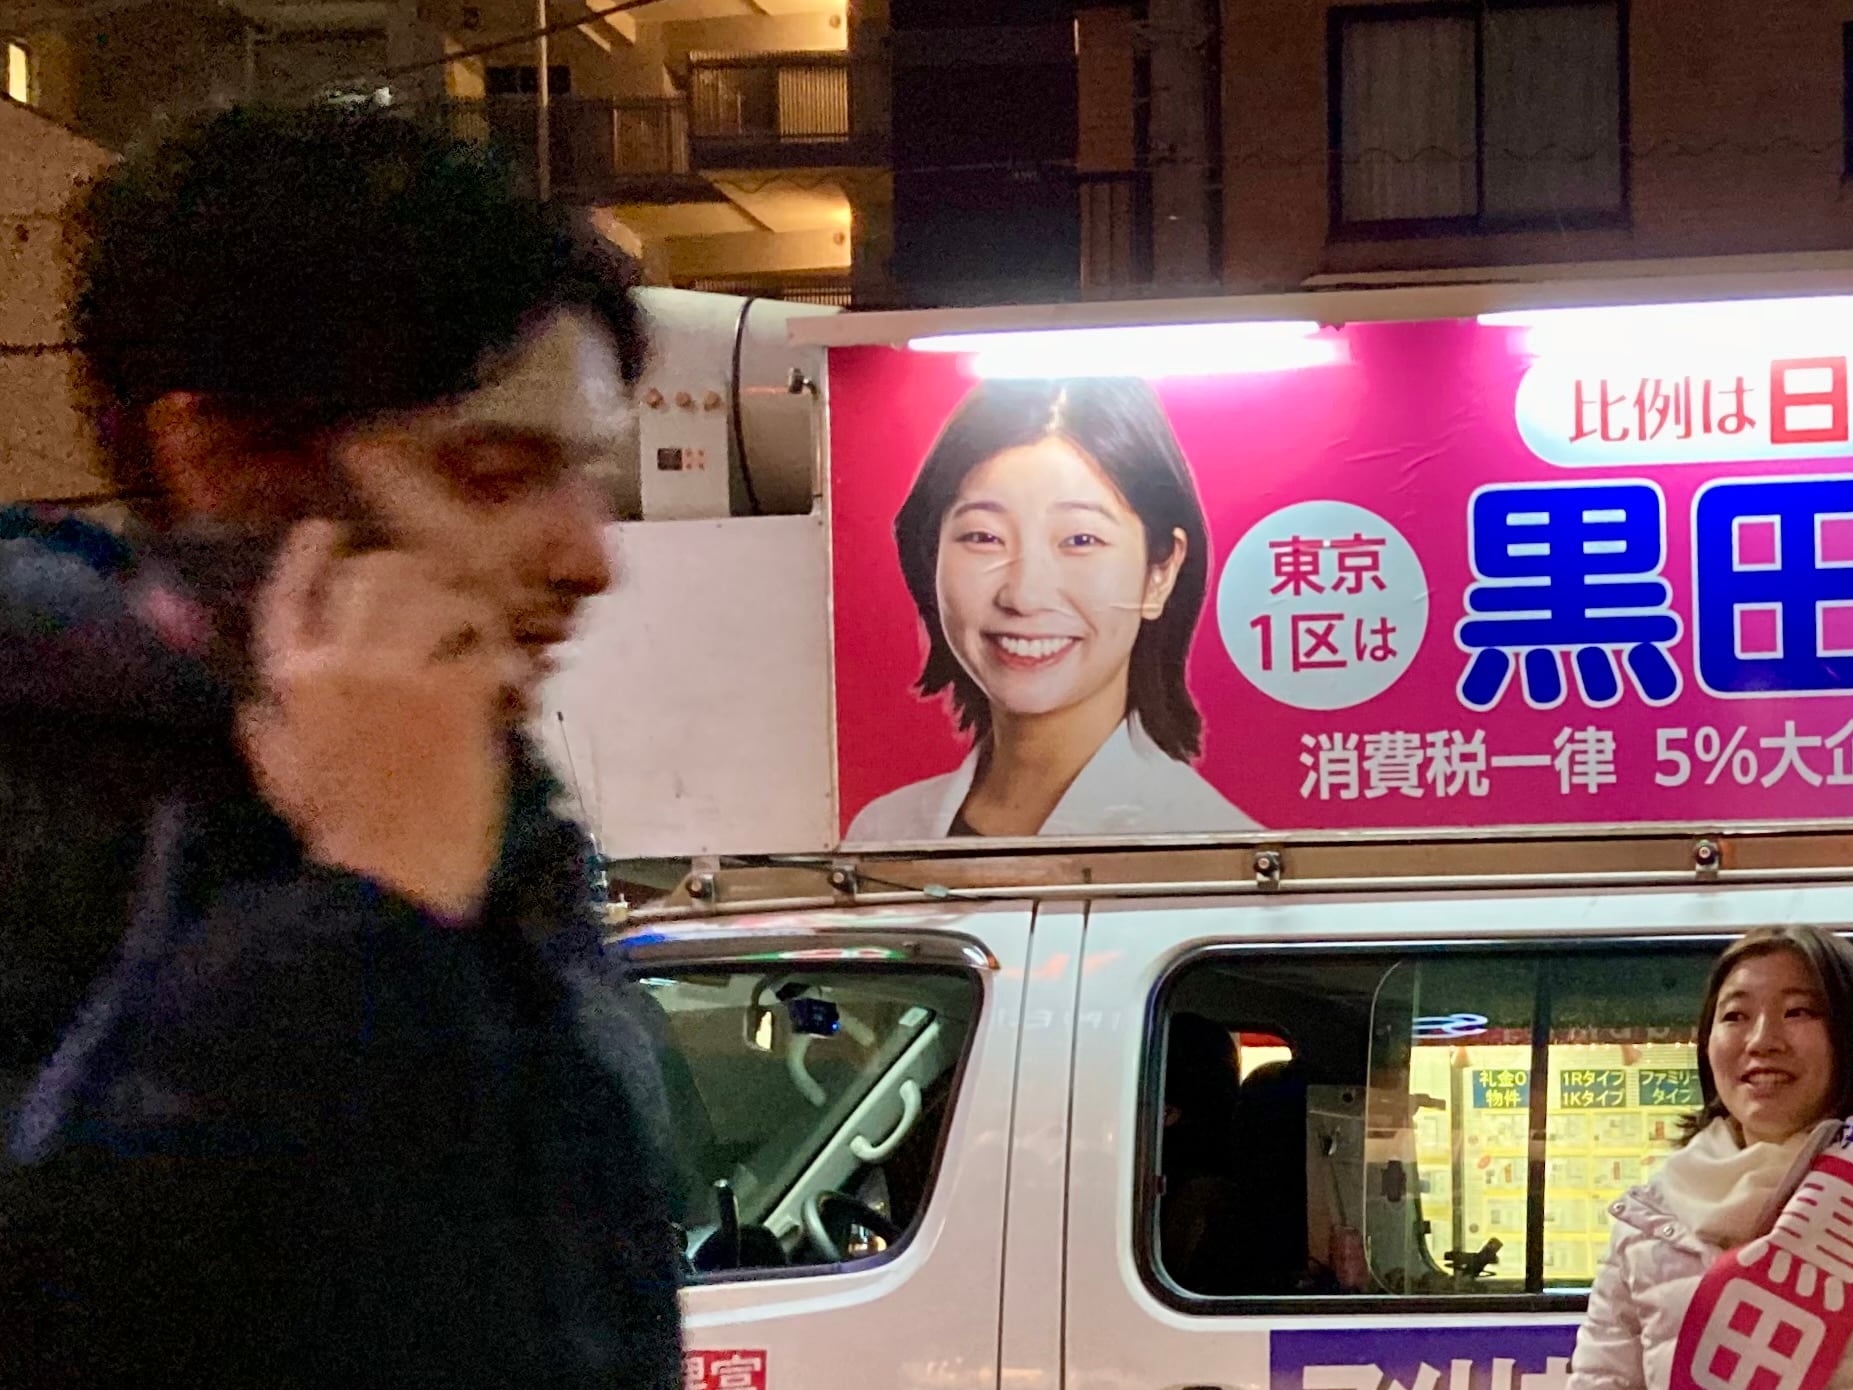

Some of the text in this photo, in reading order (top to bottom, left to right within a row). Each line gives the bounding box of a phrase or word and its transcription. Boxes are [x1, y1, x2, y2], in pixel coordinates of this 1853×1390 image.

[1268, 534, 1388, 596] 東京
[1249, 612, 1399, 673] 1区は
[1299, 726, 1618, 799] 消費税一律
[1479, 1071, 1527, 1086] 礼金0
[1562, 1070, 1625, 1086] 1Rタイプ
[1485, 1090, 1522, 1107] 物件
[1562, 1090, 1625, 1107] 1Kタイプ
[1651, 1089, 1693, 1105] タイプ
